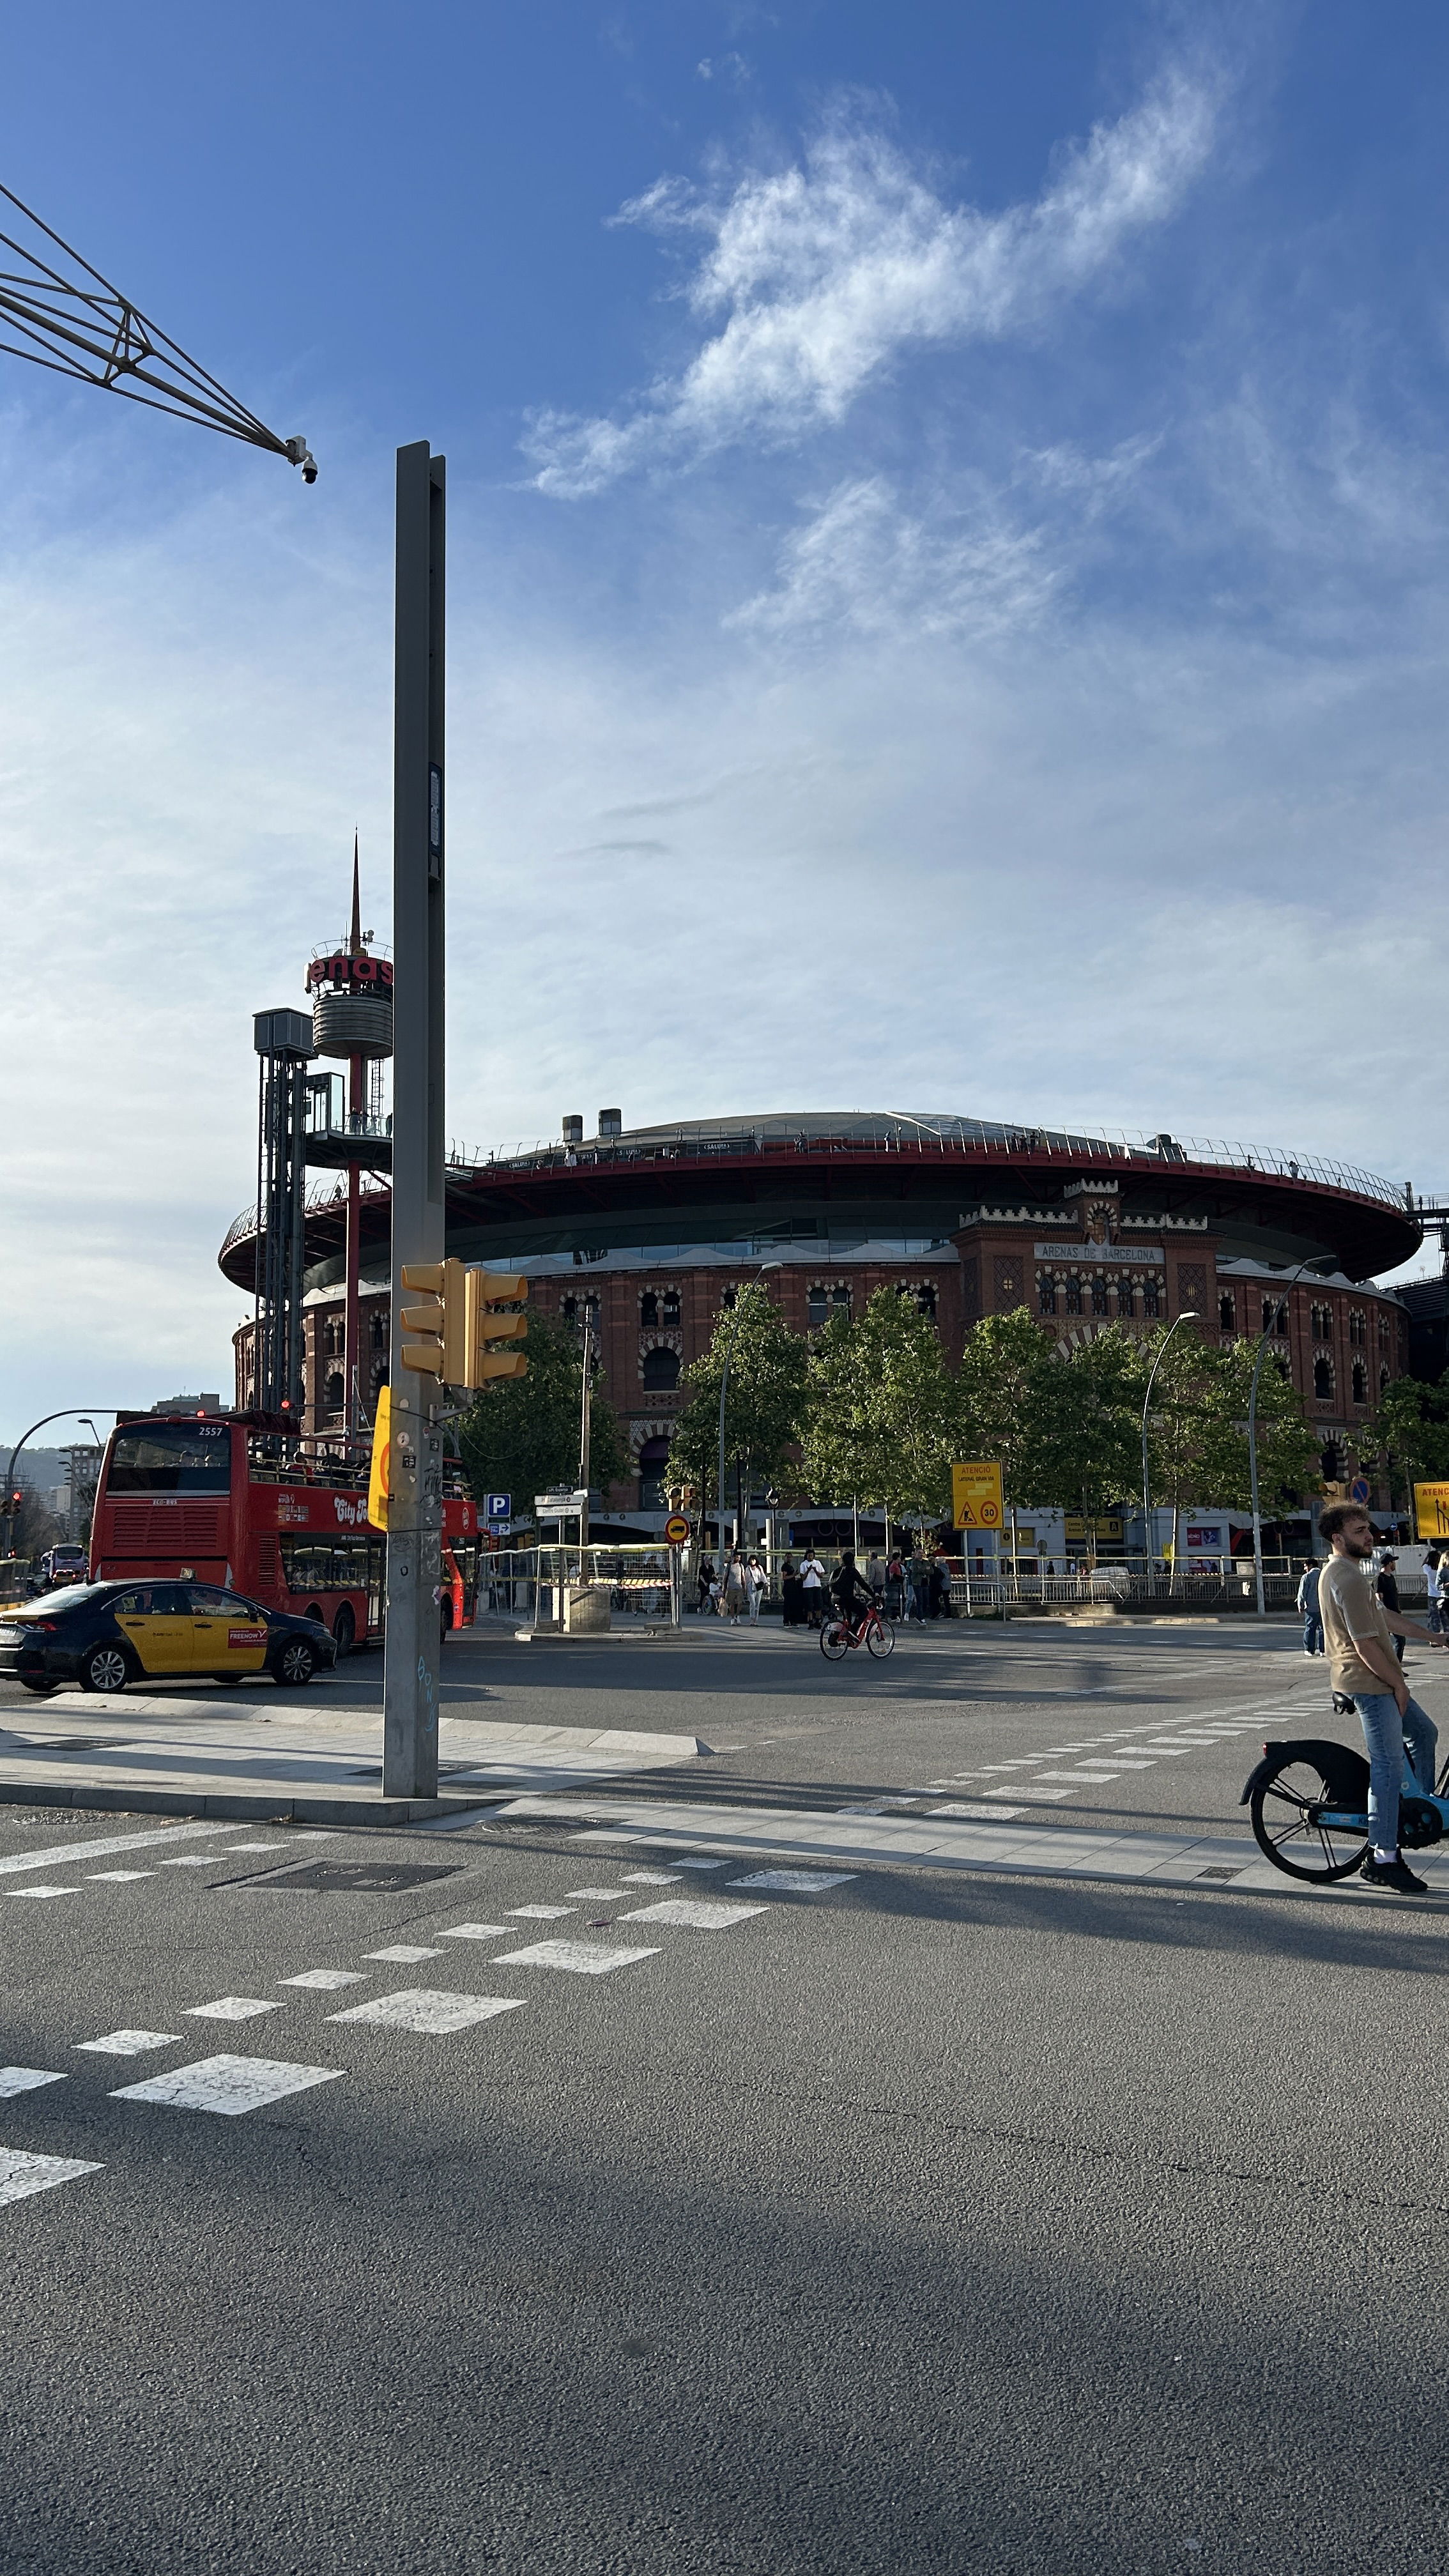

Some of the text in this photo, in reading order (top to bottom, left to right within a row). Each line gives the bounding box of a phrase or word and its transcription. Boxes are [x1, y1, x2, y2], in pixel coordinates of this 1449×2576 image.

[310, 957, 393, 985] enas
[1042, 1246, 1155, 1261] ARENAS DE BARCELONA
[199, 1427, 222, 1436] 2557
[962, 1464, 991, 1474] ATENCIÓ
[1422, 1487, 1449, 1496] ATENC
[334, 1497, 369, 1525] City To
[493, 1497, 505, 1514] P
[985, 1508, 994, 1517] 30
